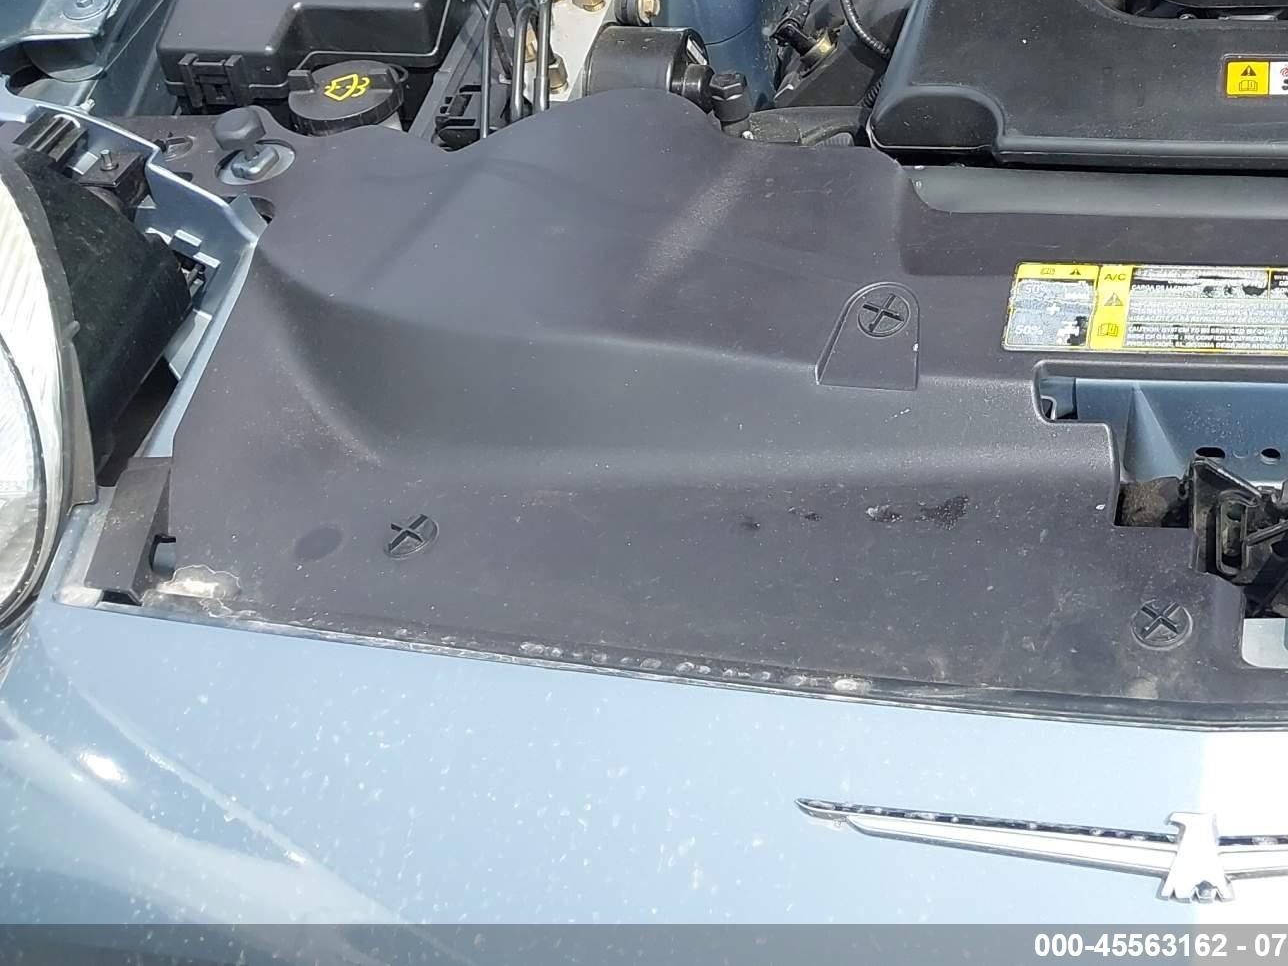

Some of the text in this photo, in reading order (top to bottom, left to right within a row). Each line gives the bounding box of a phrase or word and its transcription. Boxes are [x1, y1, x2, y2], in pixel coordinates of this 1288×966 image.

[1103, 273, 1127, 281] A/C
[1024, 282, 1052, 295] 50%
[1015, 324, 1043, 336] 50%
